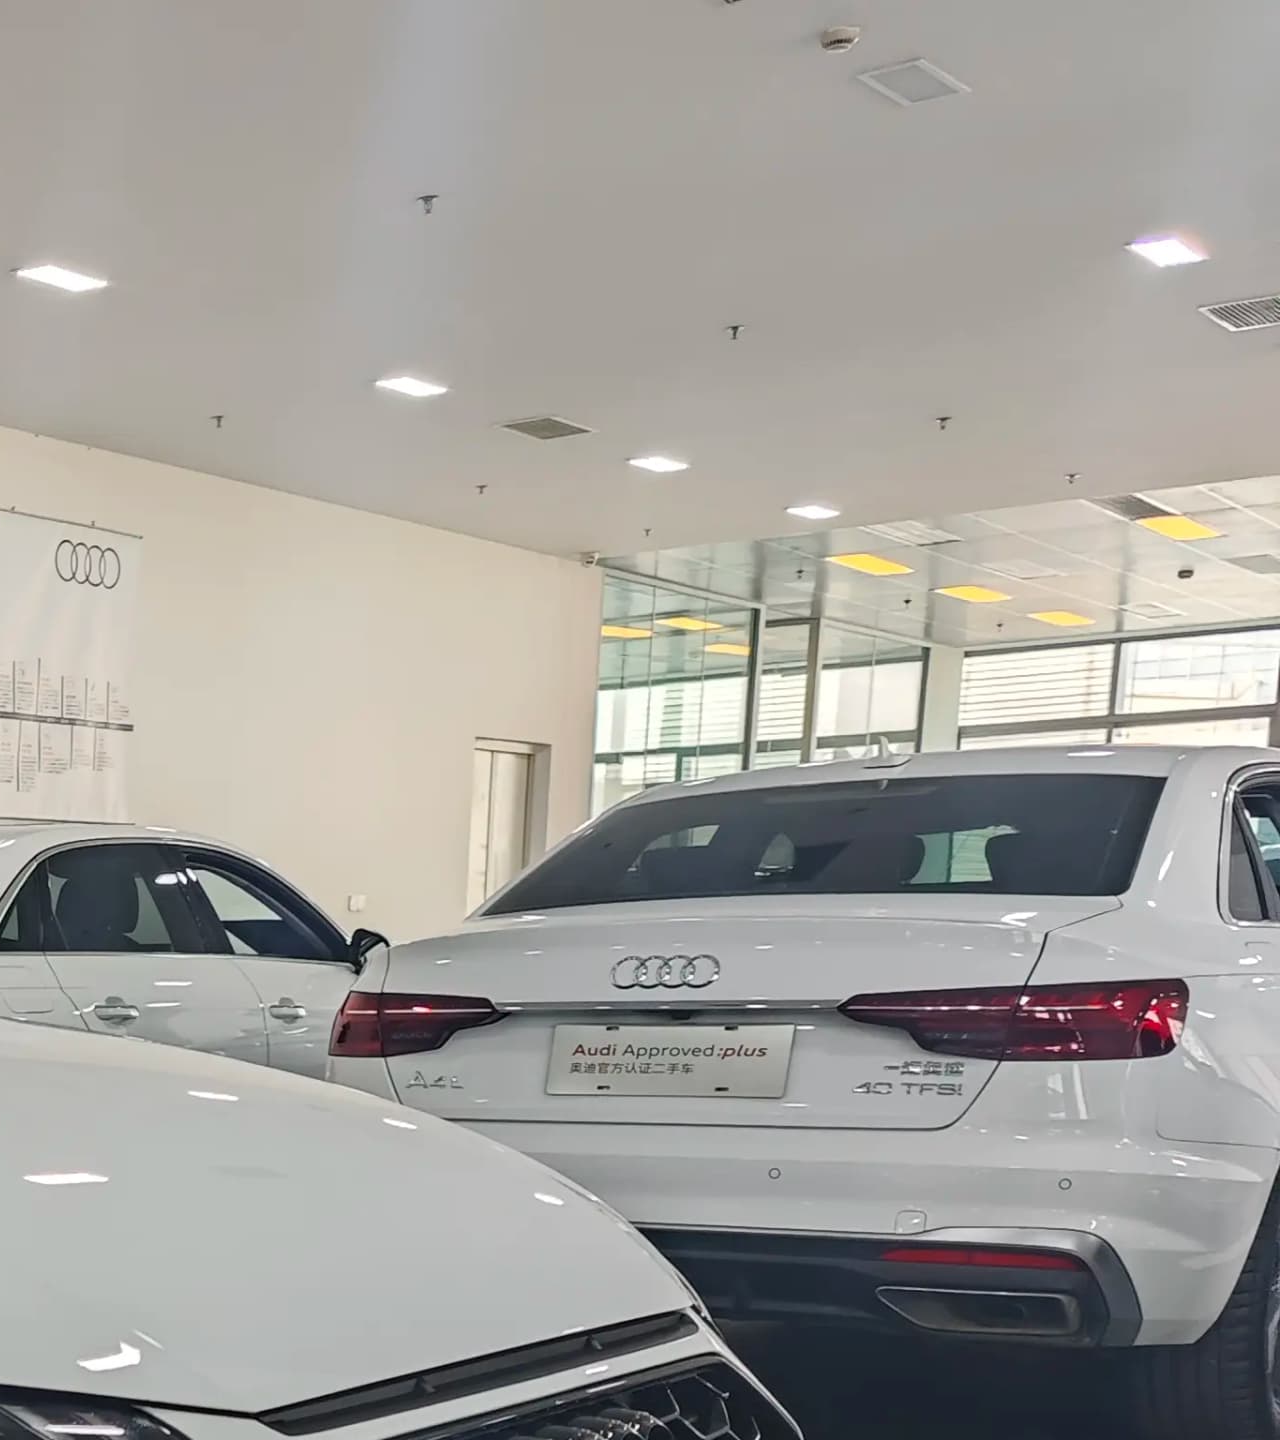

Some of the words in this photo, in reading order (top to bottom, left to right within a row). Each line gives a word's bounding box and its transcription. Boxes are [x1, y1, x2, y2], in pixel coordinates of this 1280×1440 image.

[572, 1043, 617, 1057] Audi
[569, 1062, 694, 1075] 奥迪官方认证二手车
[852, 1081, 893, 1095] 40
[900, 1082, 963, 1096] TFSI
